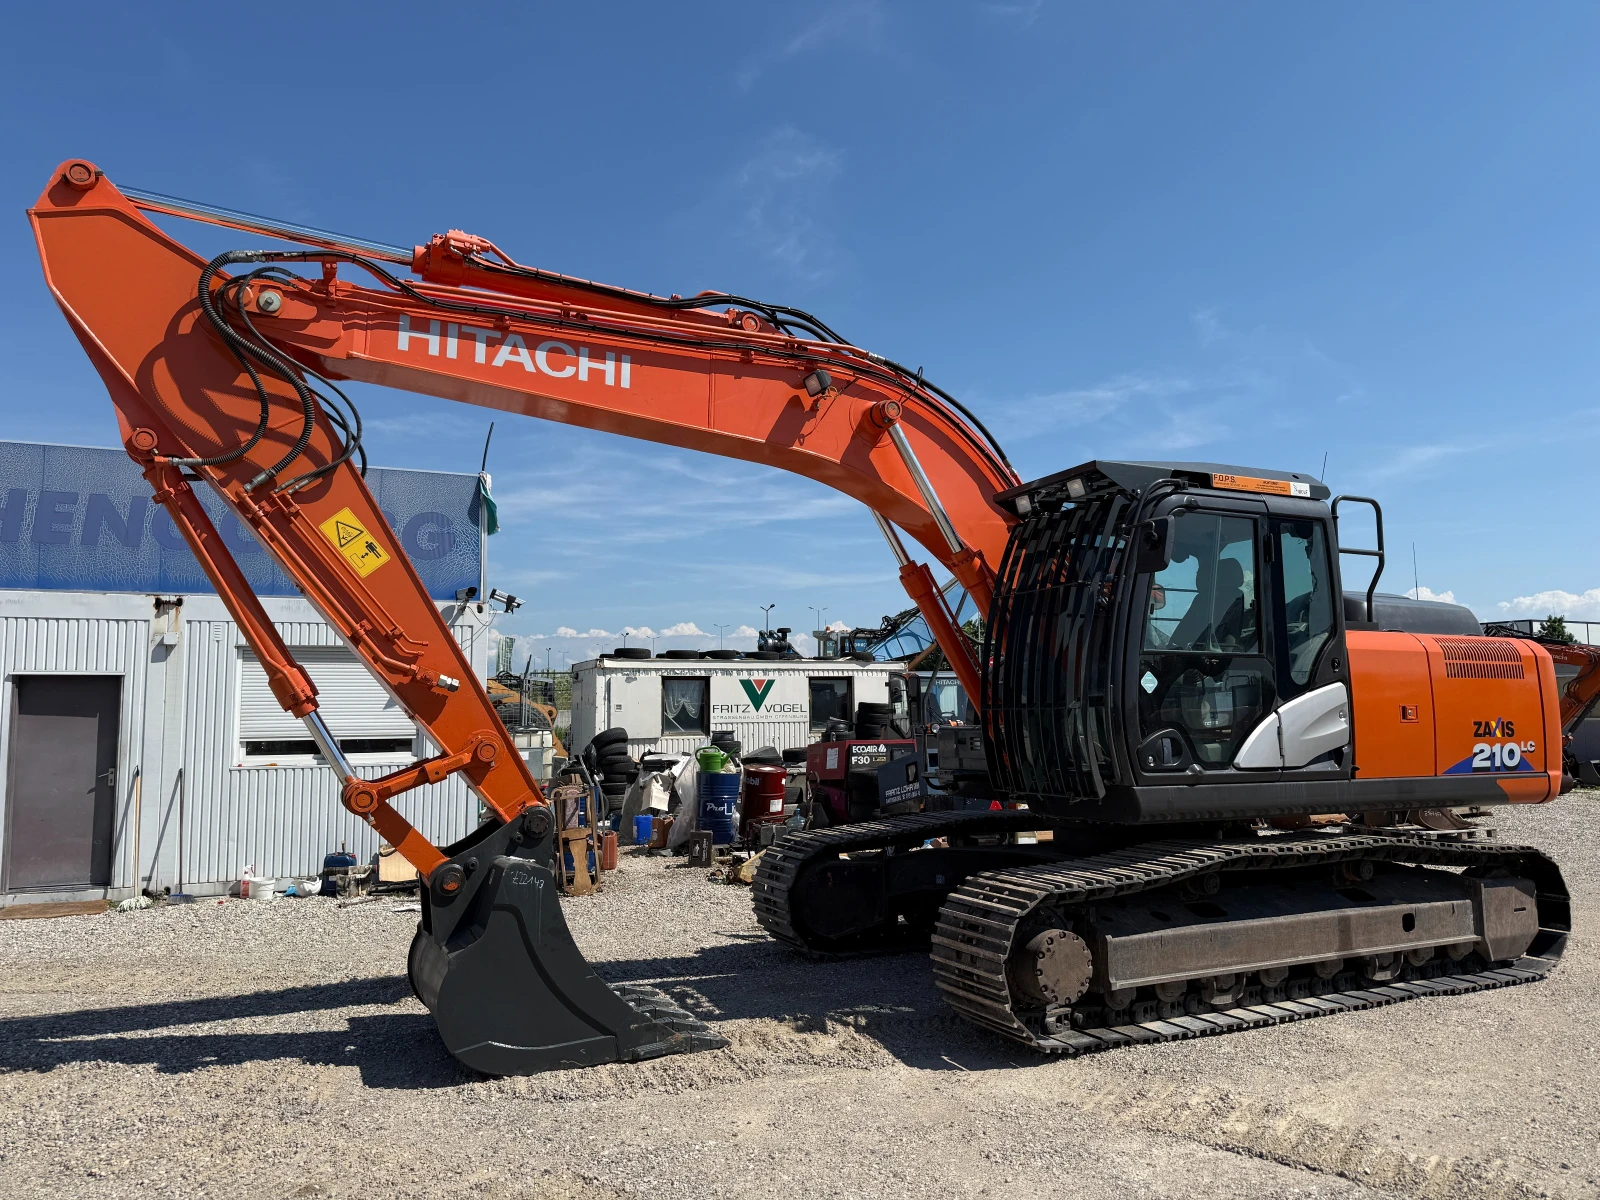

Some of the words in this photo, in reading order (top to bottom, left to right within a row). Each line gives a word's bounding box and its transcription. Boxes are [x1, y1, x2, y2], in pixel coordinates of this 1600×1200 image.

[397, 314, 631, 389] HITACHI
[712, 704, 751, 714] FRITZ
[764, 703, 808, 713] VOGEL
[1473, 717, 1515, 738] ZAXIS
[852, 745, 878, 754] ECOAIR
[1472, 742, 1521, 770] 210
[1521, 740, 1536, 752] LC
[851, 755, 871, 765] F30
